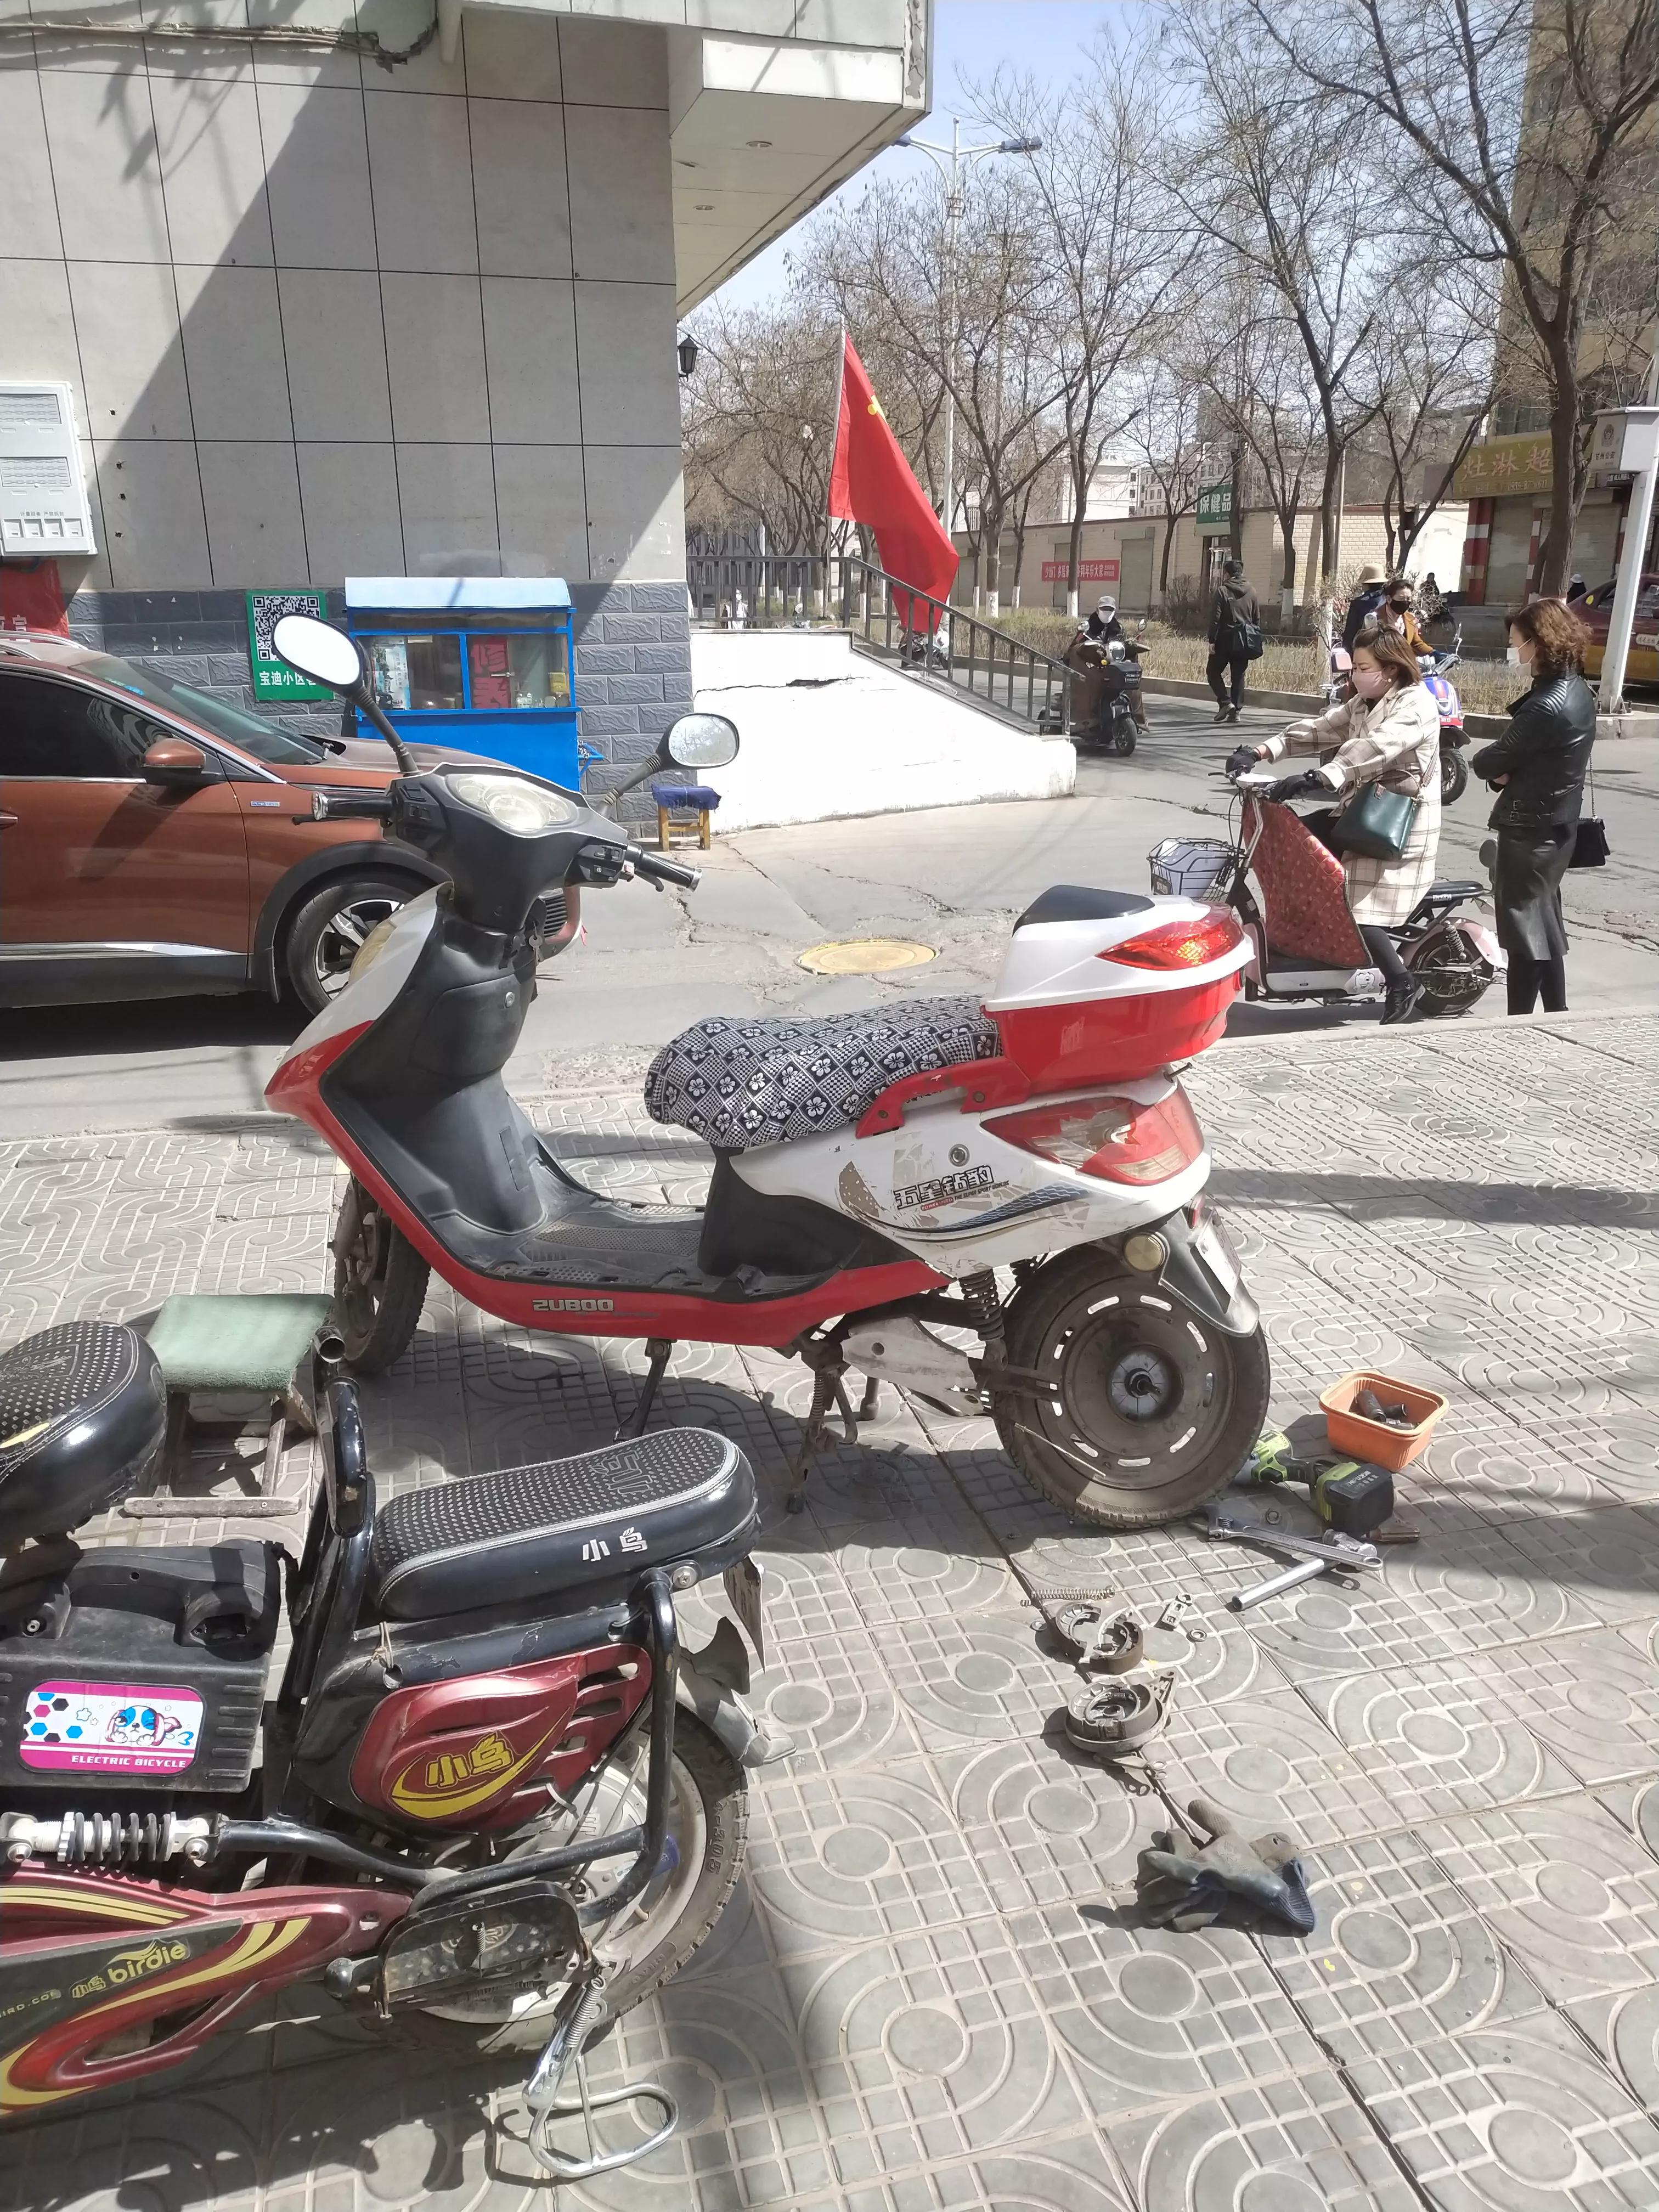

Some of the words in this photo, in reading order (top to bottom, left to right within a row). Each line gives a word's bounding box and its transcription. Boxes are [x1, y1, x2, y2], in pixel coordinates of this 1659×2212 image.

[1200, 493, 1231, 514] 保健品
[259, 671, 317, 686] 宝迪小区
[893, 1165, 994, 1210] 五星钻豹
[963, 1190, 977, 1198] SUPER
[977, 1185, 991, 1195] SPORT
[583, 1527, 648, 1562] 小鸟
[71, 1755, 131, 1765] ELECTRIC
[134, 1758, 186, 1768] BICYCLE
[427, 1733, 512, 1787] 小鸟
[108, 1943, 186, 1983] birdie
